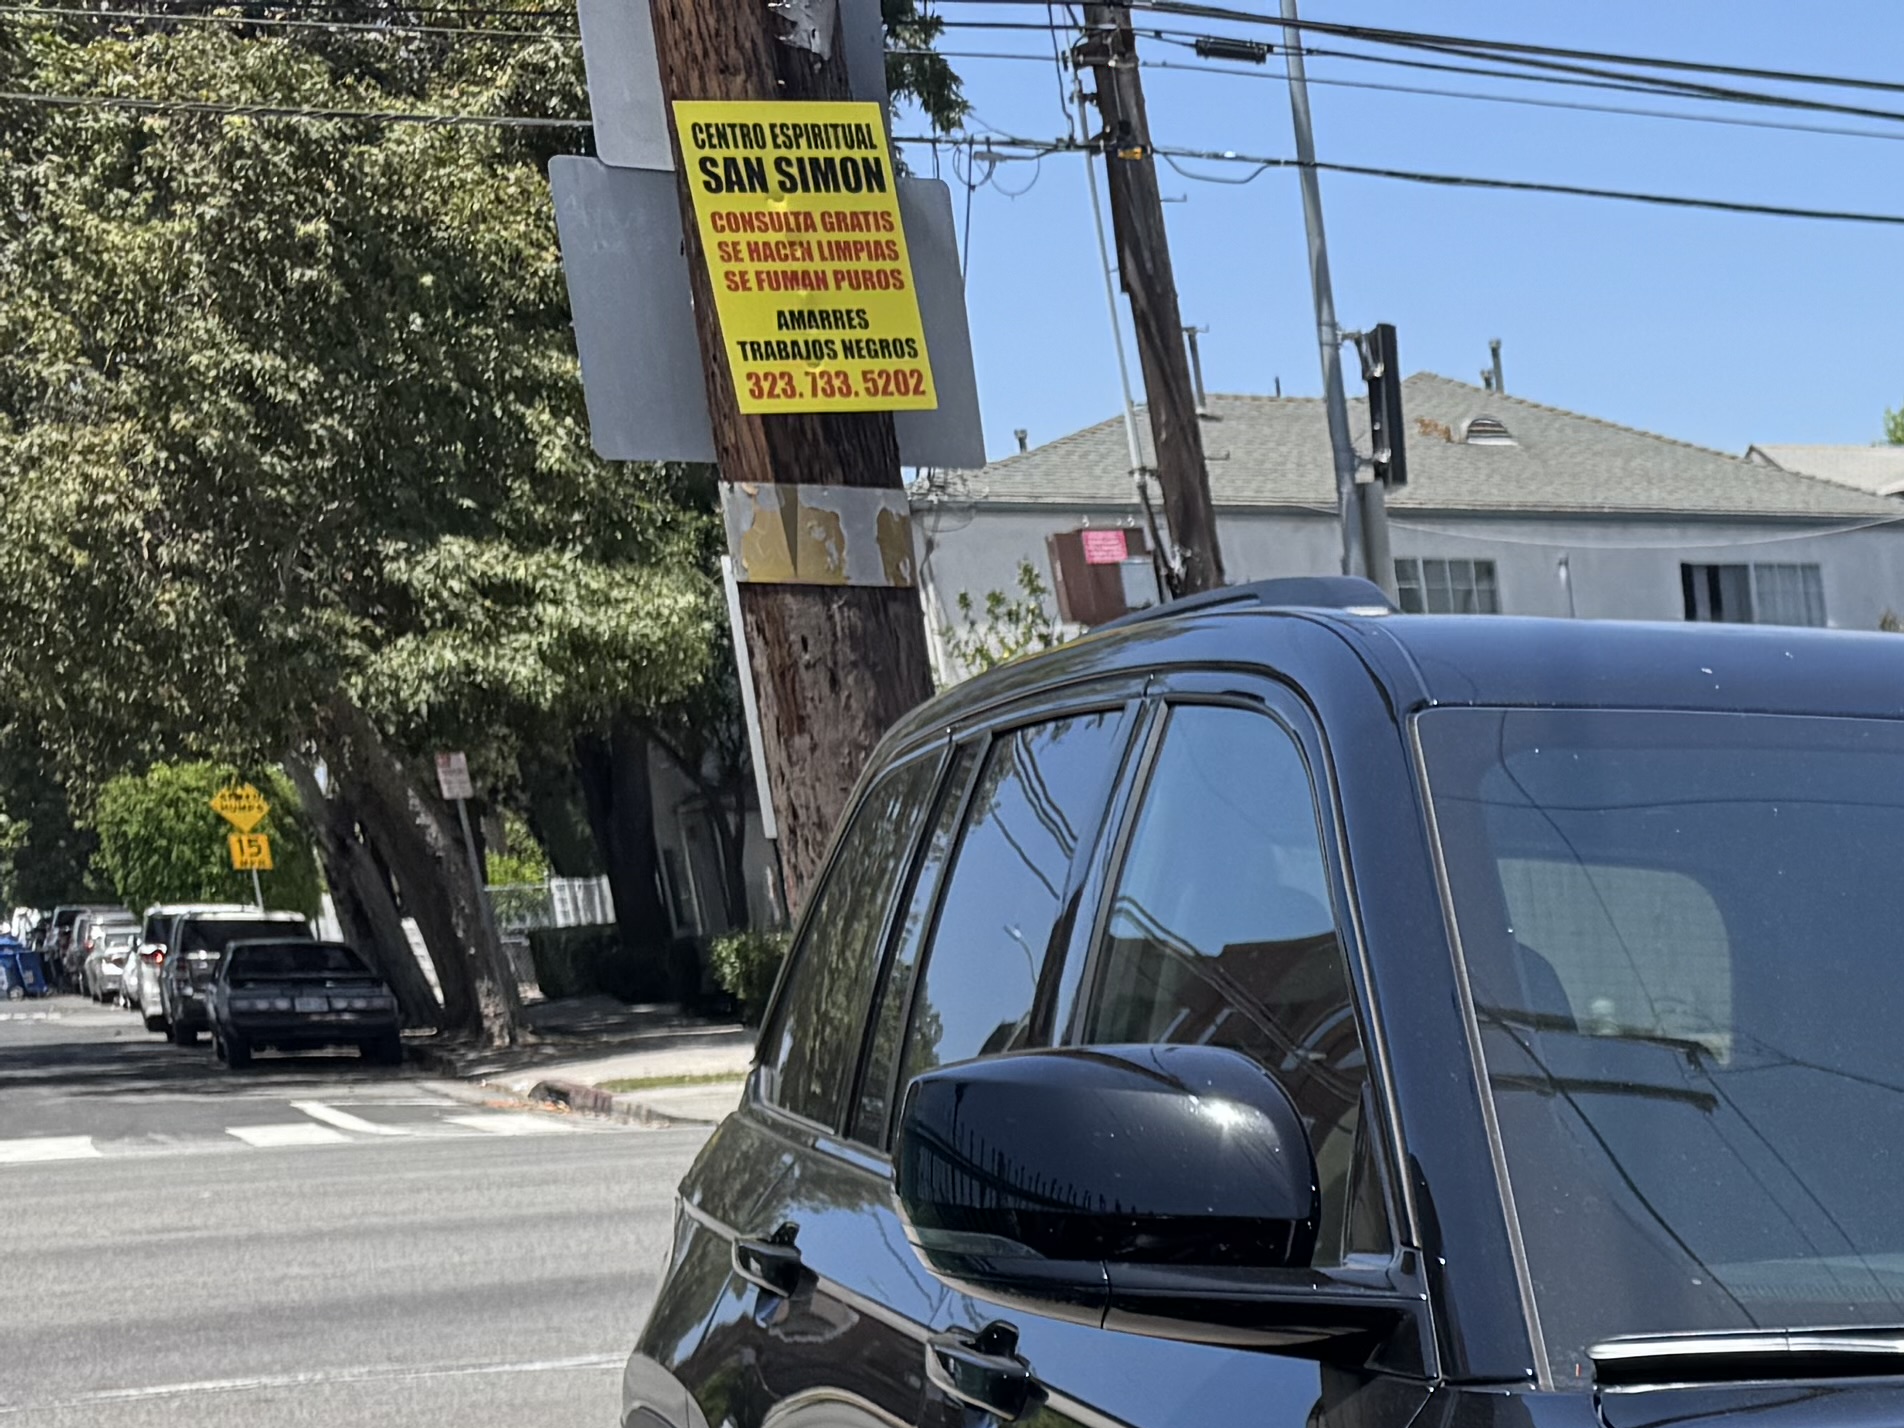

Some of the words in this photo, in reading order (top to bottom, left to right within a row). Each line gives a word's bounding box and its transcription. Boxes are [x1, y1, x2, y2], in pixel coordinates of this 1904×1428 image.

[691, 122, 767, 150] CENTRO
[769, 122, 878, 150] ESPIRITUAL
[698, 156, 769, 194] SAN
[774, 156, 887, 194] SIMON
[710, 211, 817, 233] CONSULTA
[820, 211, 895, 233] GRATIS
[717, 241, 745, 263] SE
[746, 240, 815, 262] HACEN
[816, 239, 900, 262] LIMPIAS
[724, 270, 752, 292] SE
[755, 269, 829, 291] FUMAN
[833, 268, 905, 291] PUROS
[776, 308, 870, 331] AMARRES
[736, 339, 838, 361] TRABAJOS
[841, 338, 919, 360] NEGROS
[238, 837, 262, 857] 15
